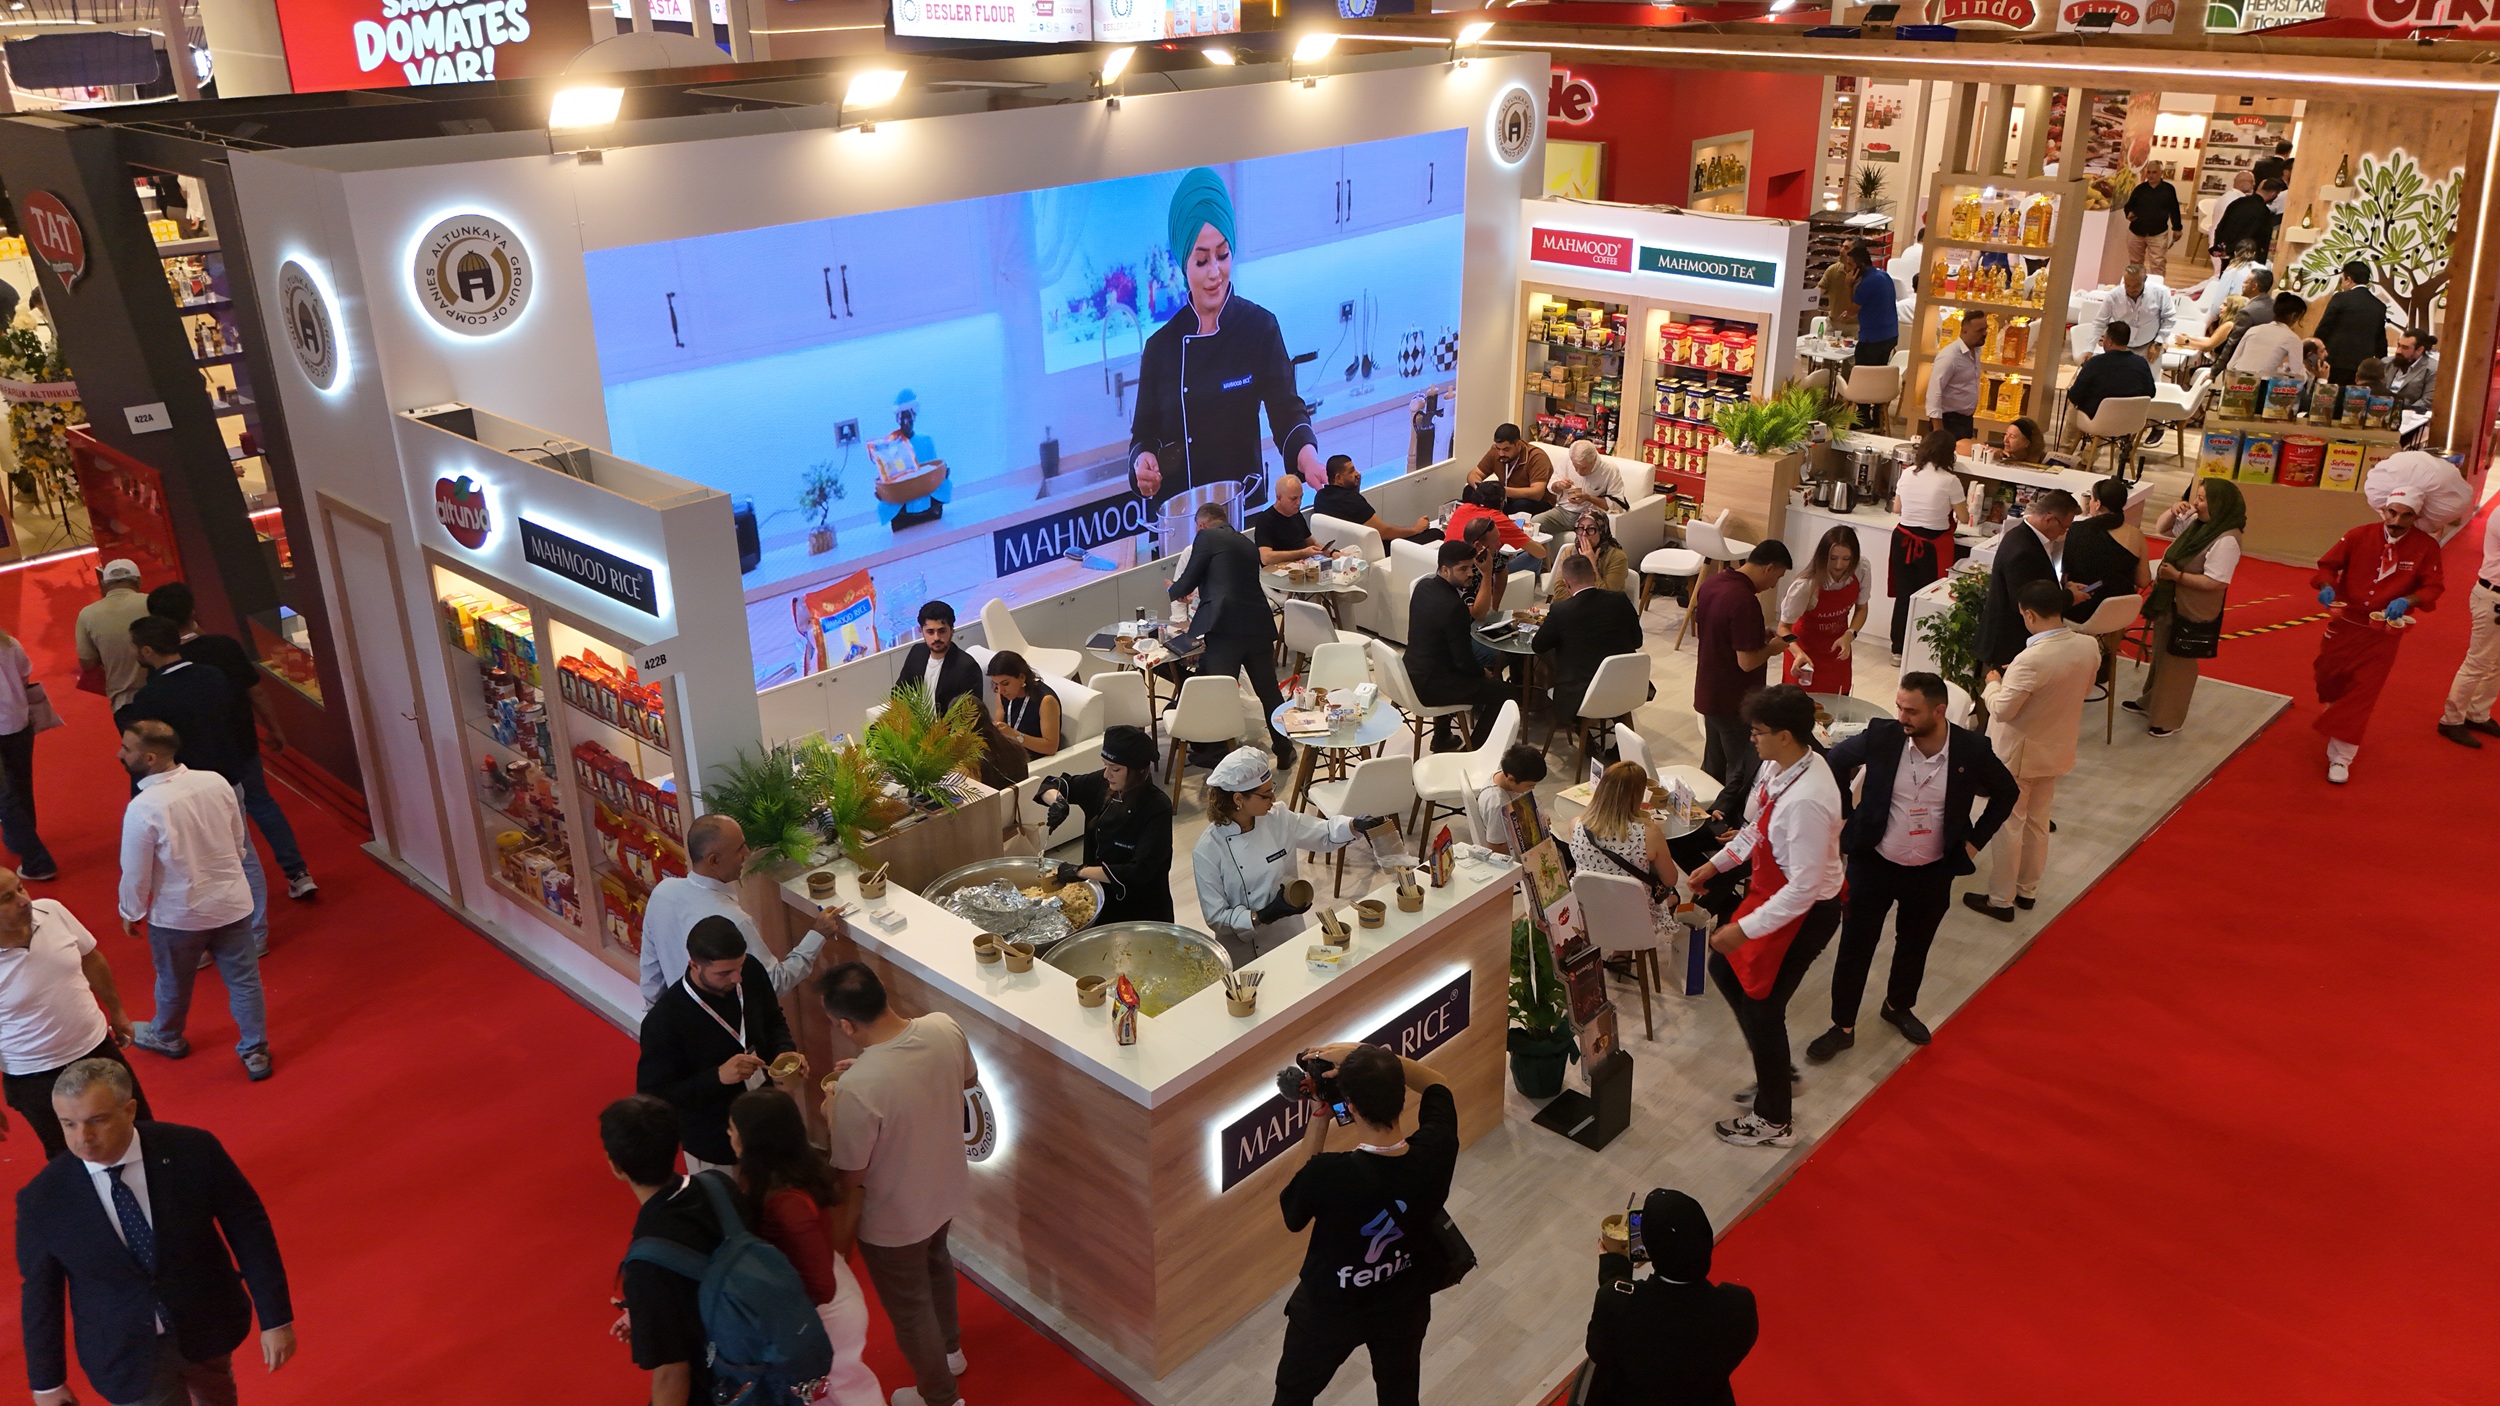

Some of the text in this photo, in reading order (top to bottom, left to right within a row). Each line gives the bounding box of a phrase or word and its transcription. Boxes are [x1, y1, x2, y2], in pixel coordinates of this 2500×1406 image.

[926, 3, 972, 21] BESLER
[976, 6, 1015, 23] FLOUR
[354, 0, 530, 72] DOMATES
[403, 46, 495, 86] VAR!
[2237, 117, 2264, 125] Lindo
[30, 206, 74, 255] TAT
[431, 226, 508, 259] ALTUNKAYA
[1592, 254, 1618, 266] COFFEE
[1657, 254, 1729, 277] MAHMOOD
[426, 255, 523, 325] GROUP OF COMPANIES
[134, 414, 154, 424] 422A
[435, 501, 491, 532] altunsa
[531, 535, 607, 585] MAHMOOD
[644, 654, 667, 671] 422B
[980, 1111, 993, 1154] GROUP
